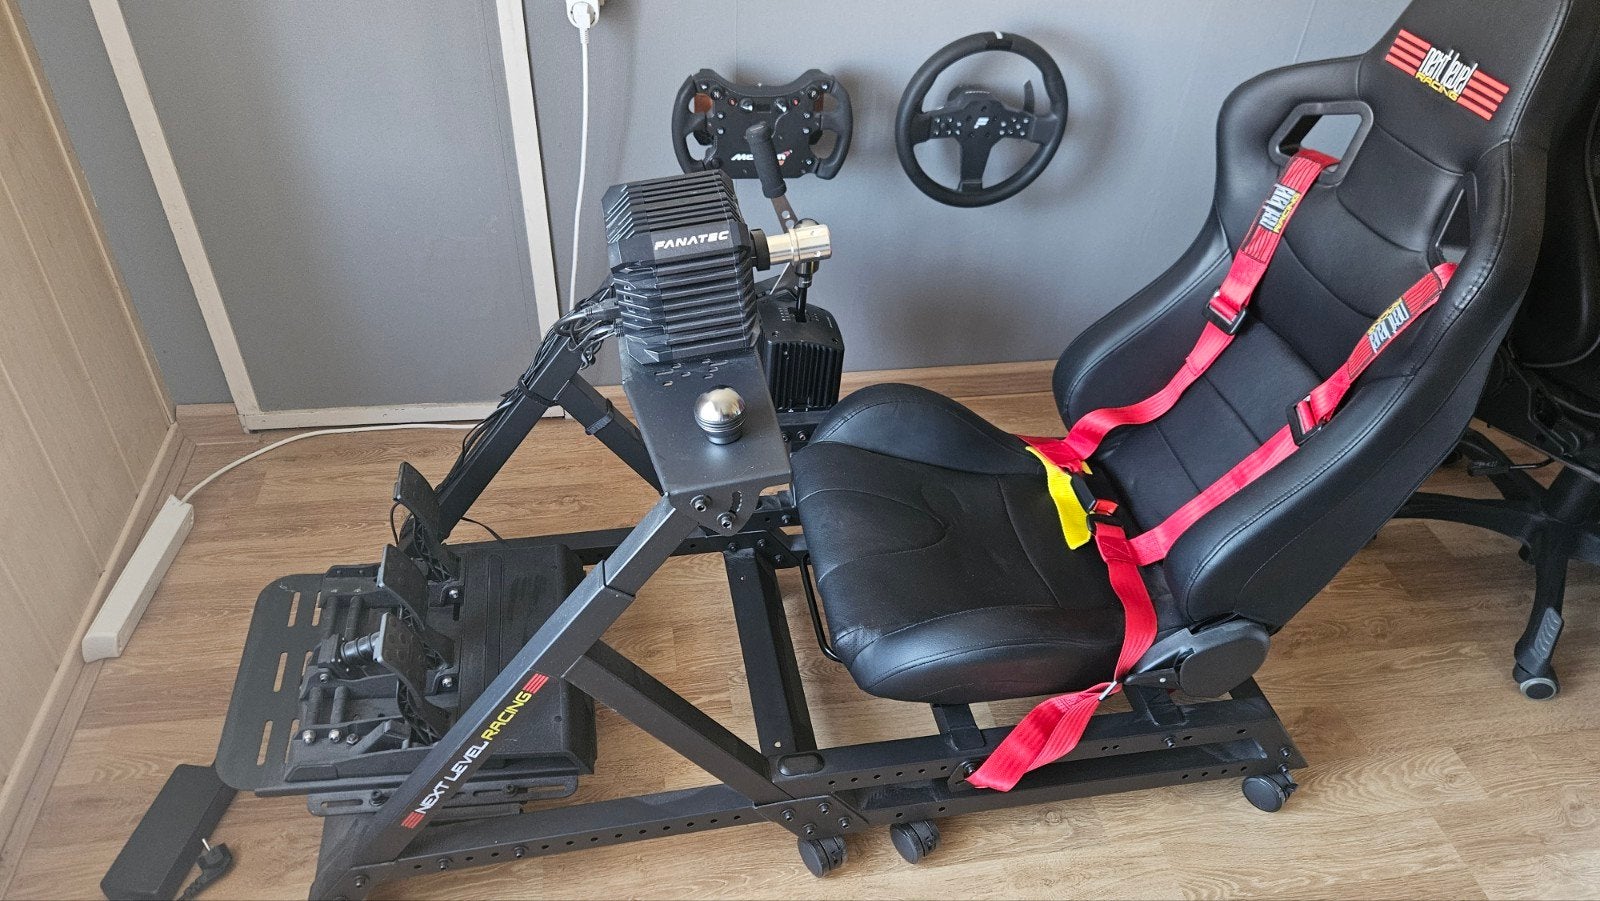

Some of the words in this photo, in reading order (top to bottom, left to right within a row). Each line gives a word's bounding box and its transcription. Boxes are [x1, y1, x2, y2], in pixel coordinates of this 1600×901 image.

[1415, 71, 1459, 102] RACING
[654, 230, 730, 251] FANATEC
[414, 780, 450, 814] NEXT
[444, 741, 490, 782] LEVEL
[481, 691, 532, 741] RACING
